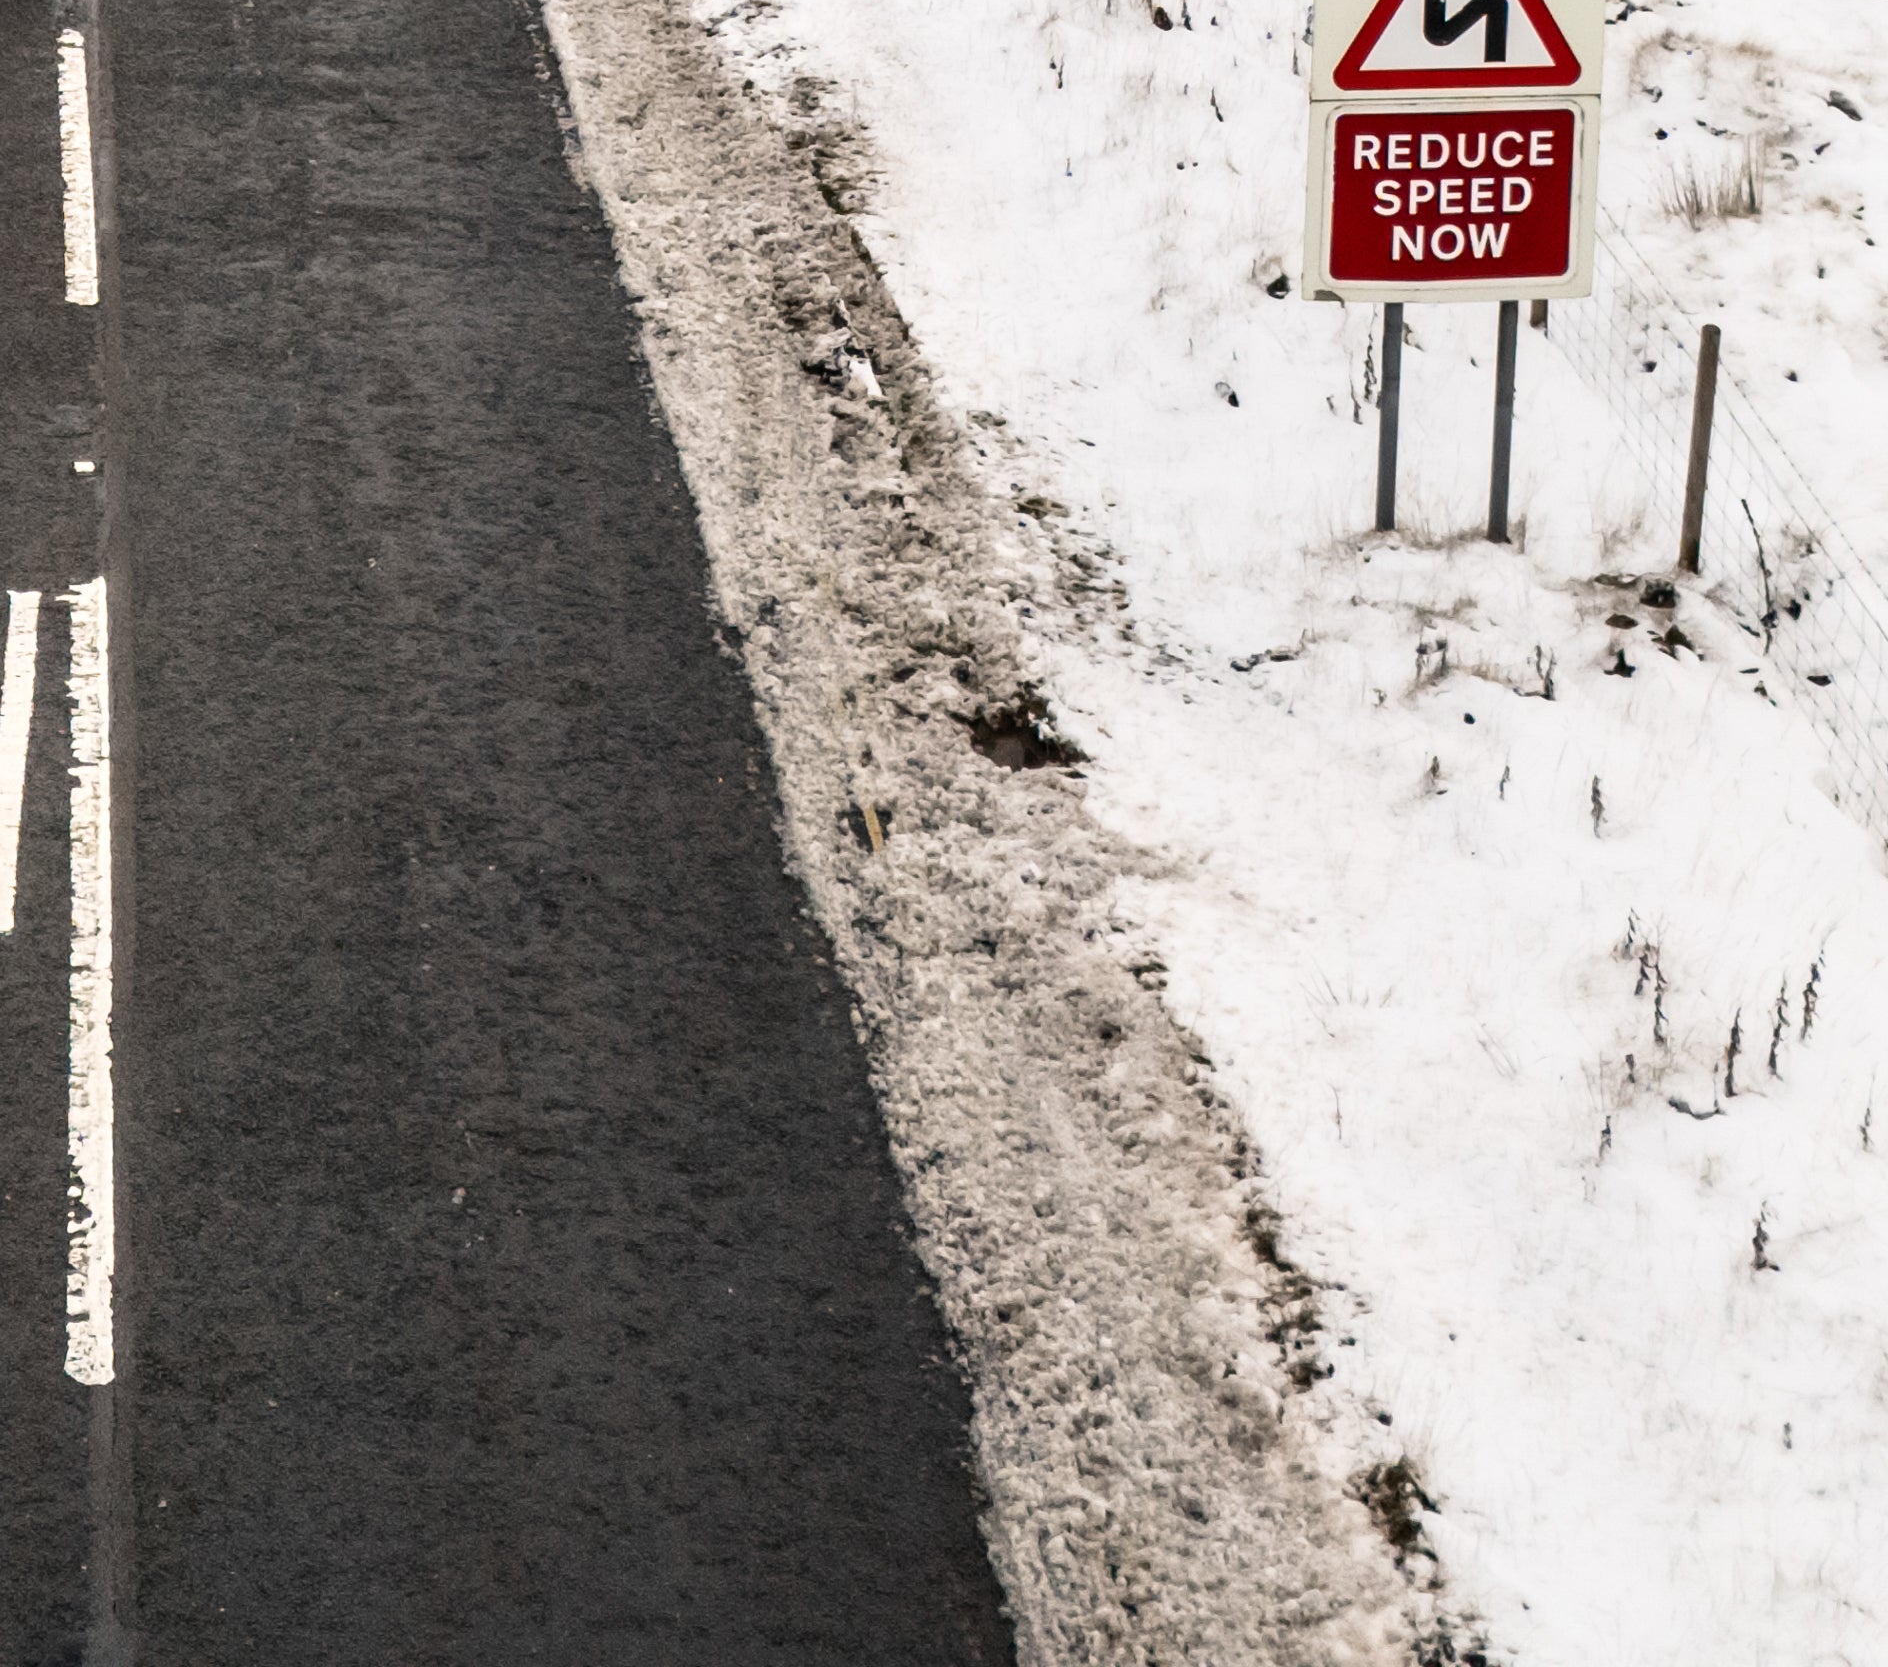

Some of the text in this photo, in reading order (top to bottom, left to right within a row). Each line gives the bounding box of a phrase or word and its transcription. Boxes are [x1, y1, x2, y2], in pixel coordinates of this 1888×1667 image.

[1353, 130, 1554, 170] REDUCE
[1373, 176, 1533, 216] SPEED
[1392, 222, 1510, 261] NOW
